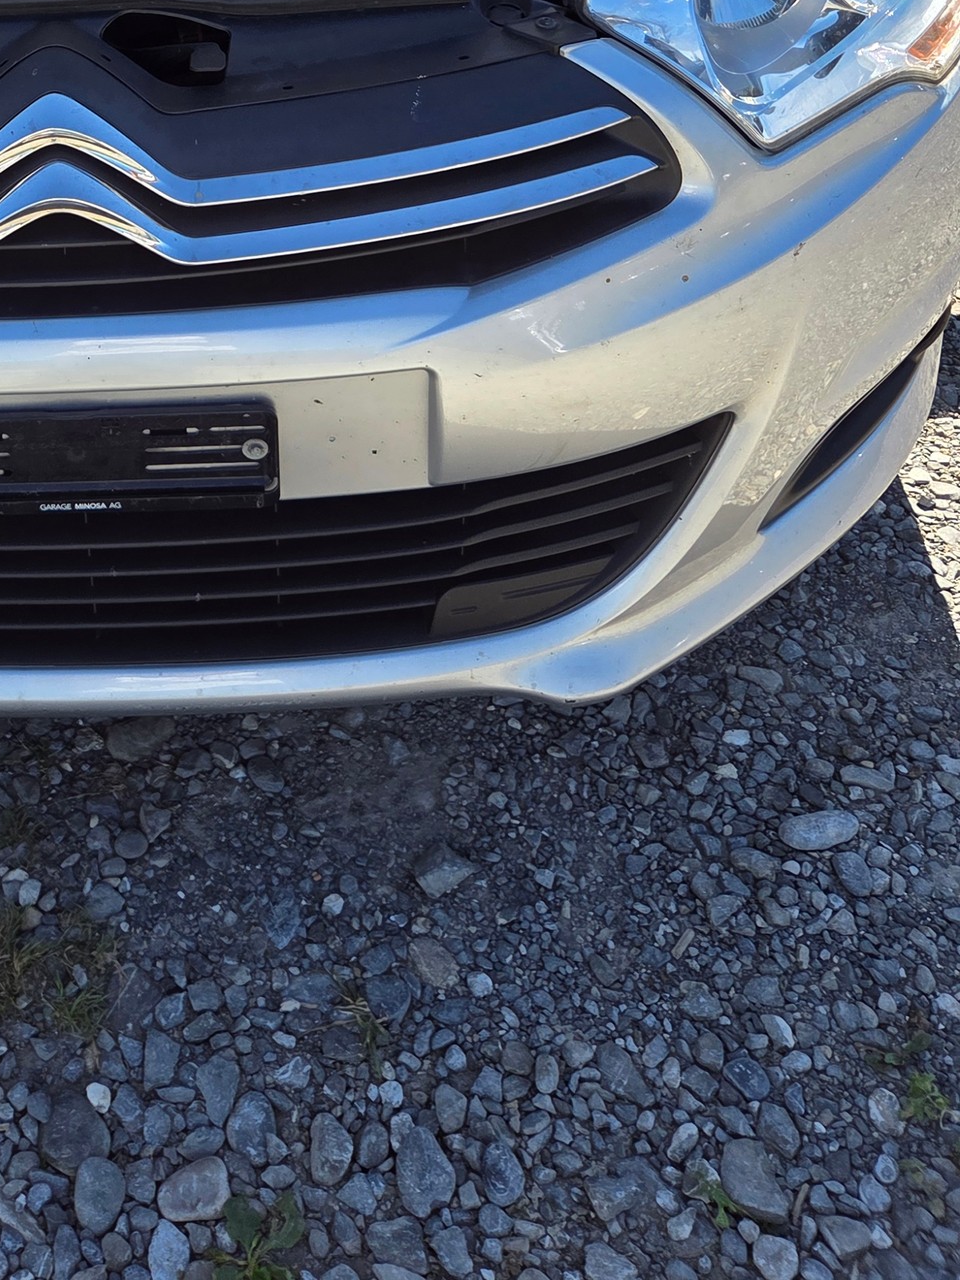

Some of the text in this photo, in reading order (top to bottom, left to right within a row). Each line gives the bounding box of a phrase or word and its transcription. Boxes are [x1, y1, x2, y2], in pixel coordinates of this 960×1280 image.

[39, 501, 122, 511] GARAGE MINOSA AG
